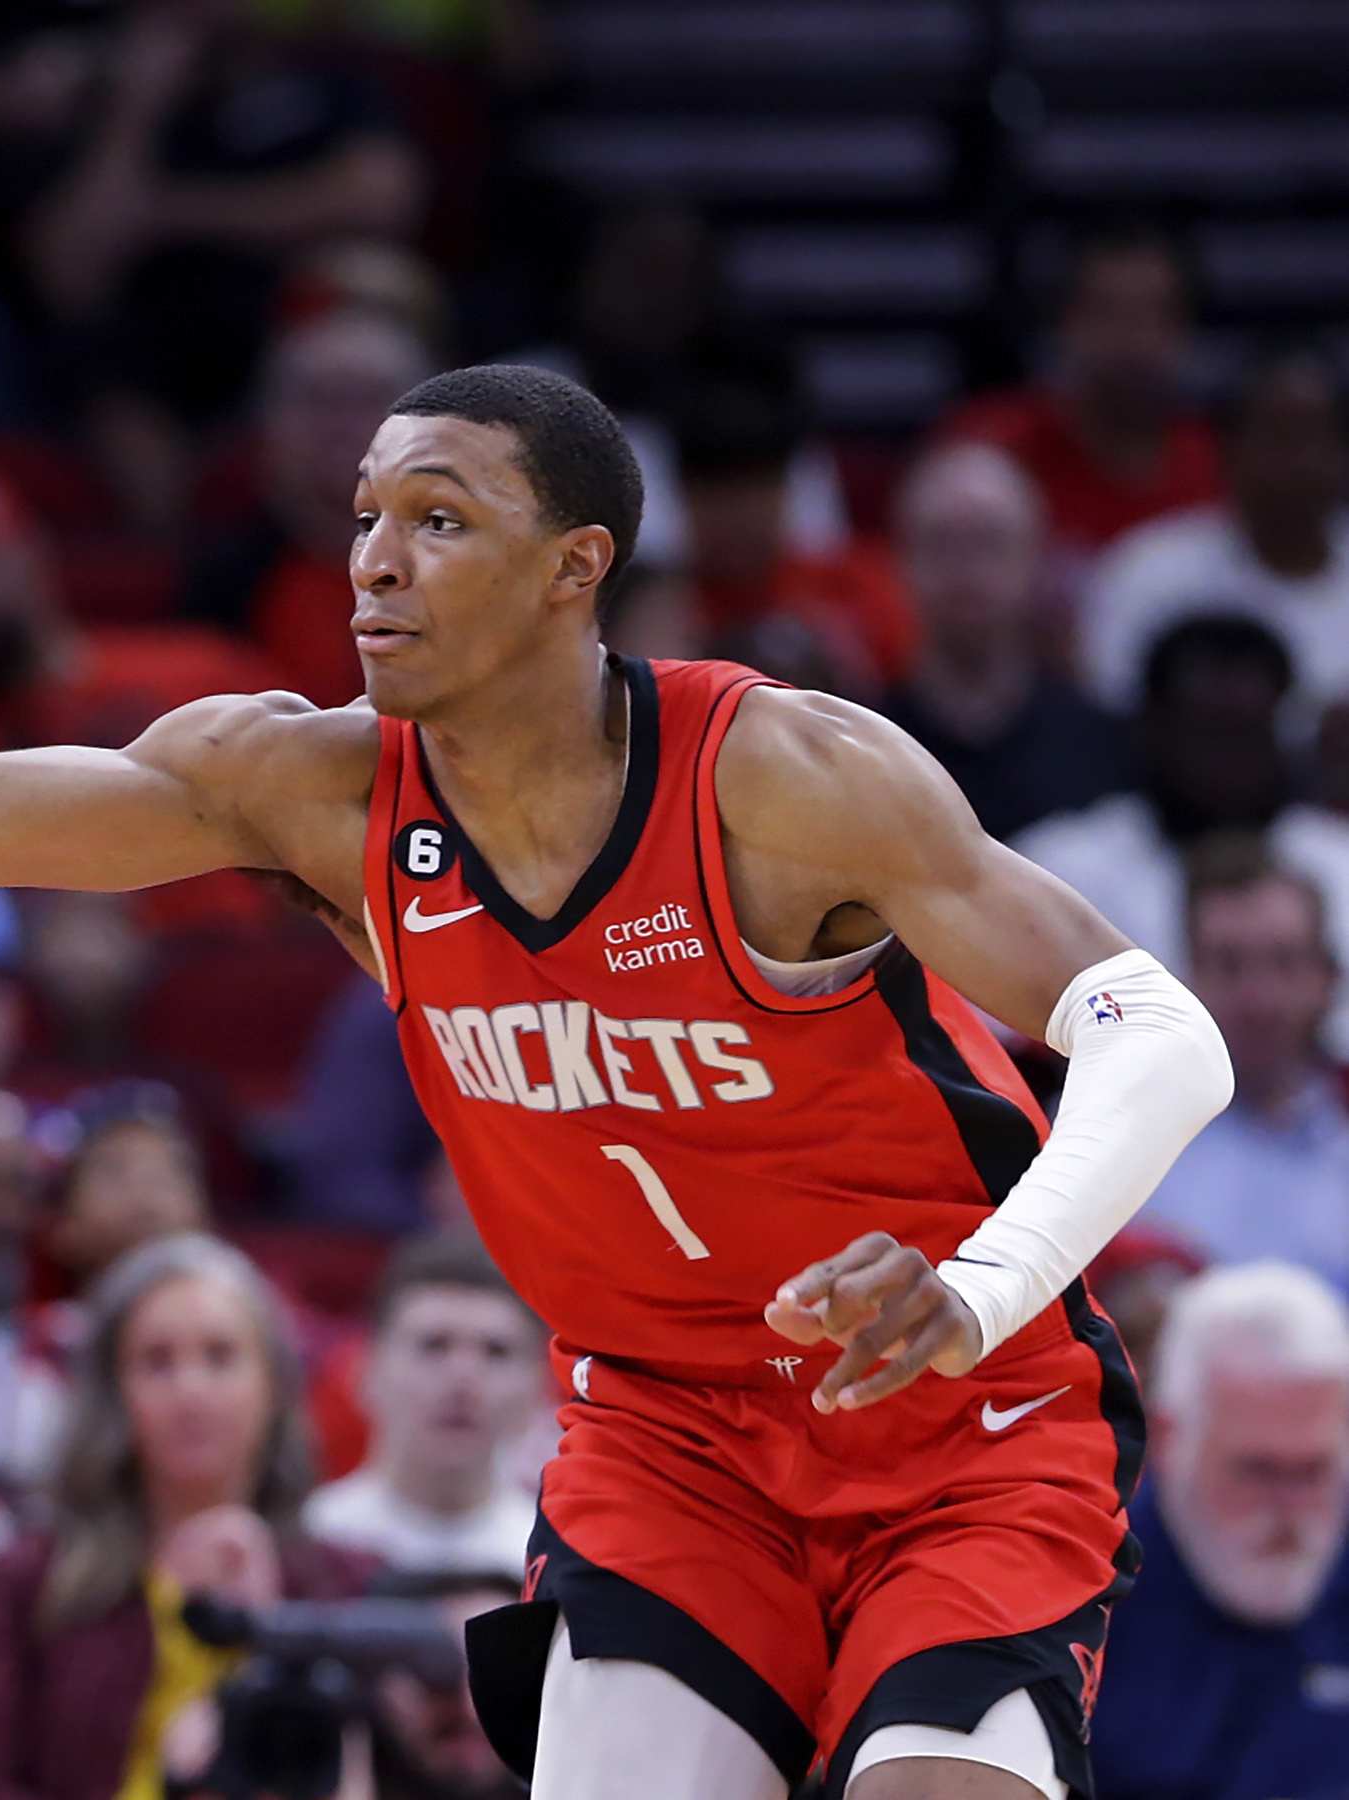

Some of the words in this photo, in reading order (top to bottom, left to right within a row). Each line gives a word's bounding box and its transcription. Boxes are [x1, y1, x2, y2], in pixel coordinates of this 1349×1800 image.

[408, 828, 442, 874] 6
[604, 903, 692, 944] credit
[604, 937, 705, 973] karma
[422, 1000, 775, 1113] ROCKETS
[600, 1143, 711, 1261] 1
